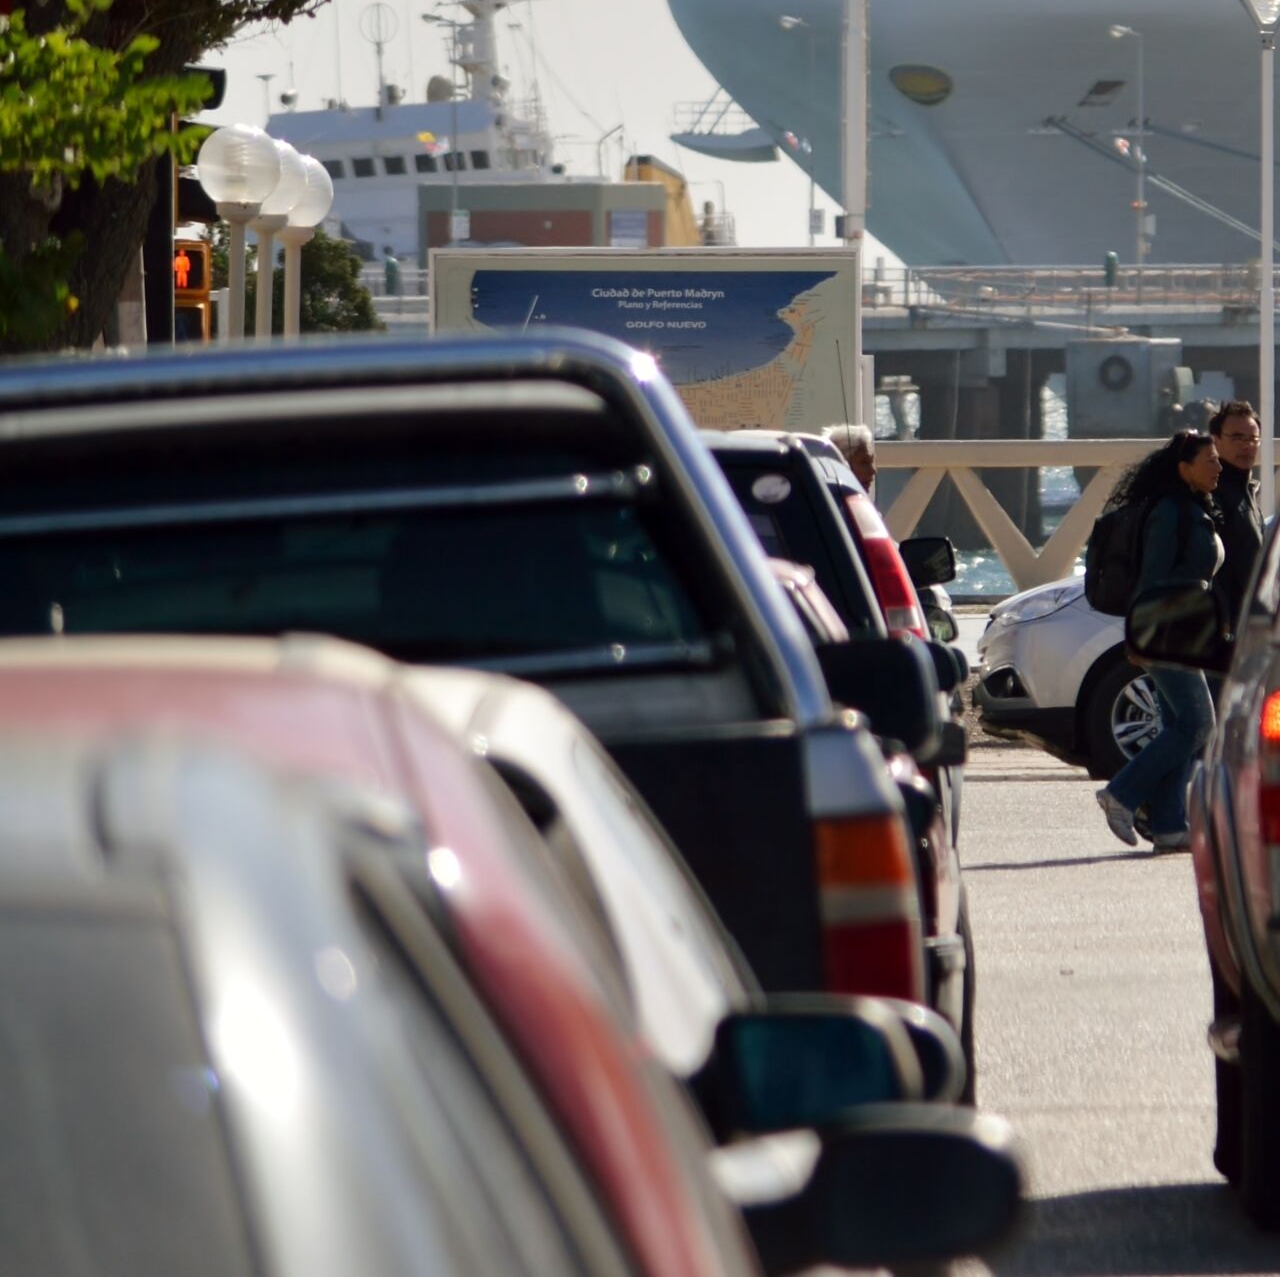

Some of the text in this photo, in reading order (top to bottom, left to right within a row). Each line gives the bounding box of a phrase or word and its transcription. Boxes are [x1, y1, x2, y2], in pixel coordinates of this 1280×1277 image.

[591, 287, 725, 301] Ciudad de Puerto Madryn
[618, 300, 644, 310] Plano
[652, 300, 704, 311] Referencias
[625, 320, 707, 330] GOLFO NUEVO
